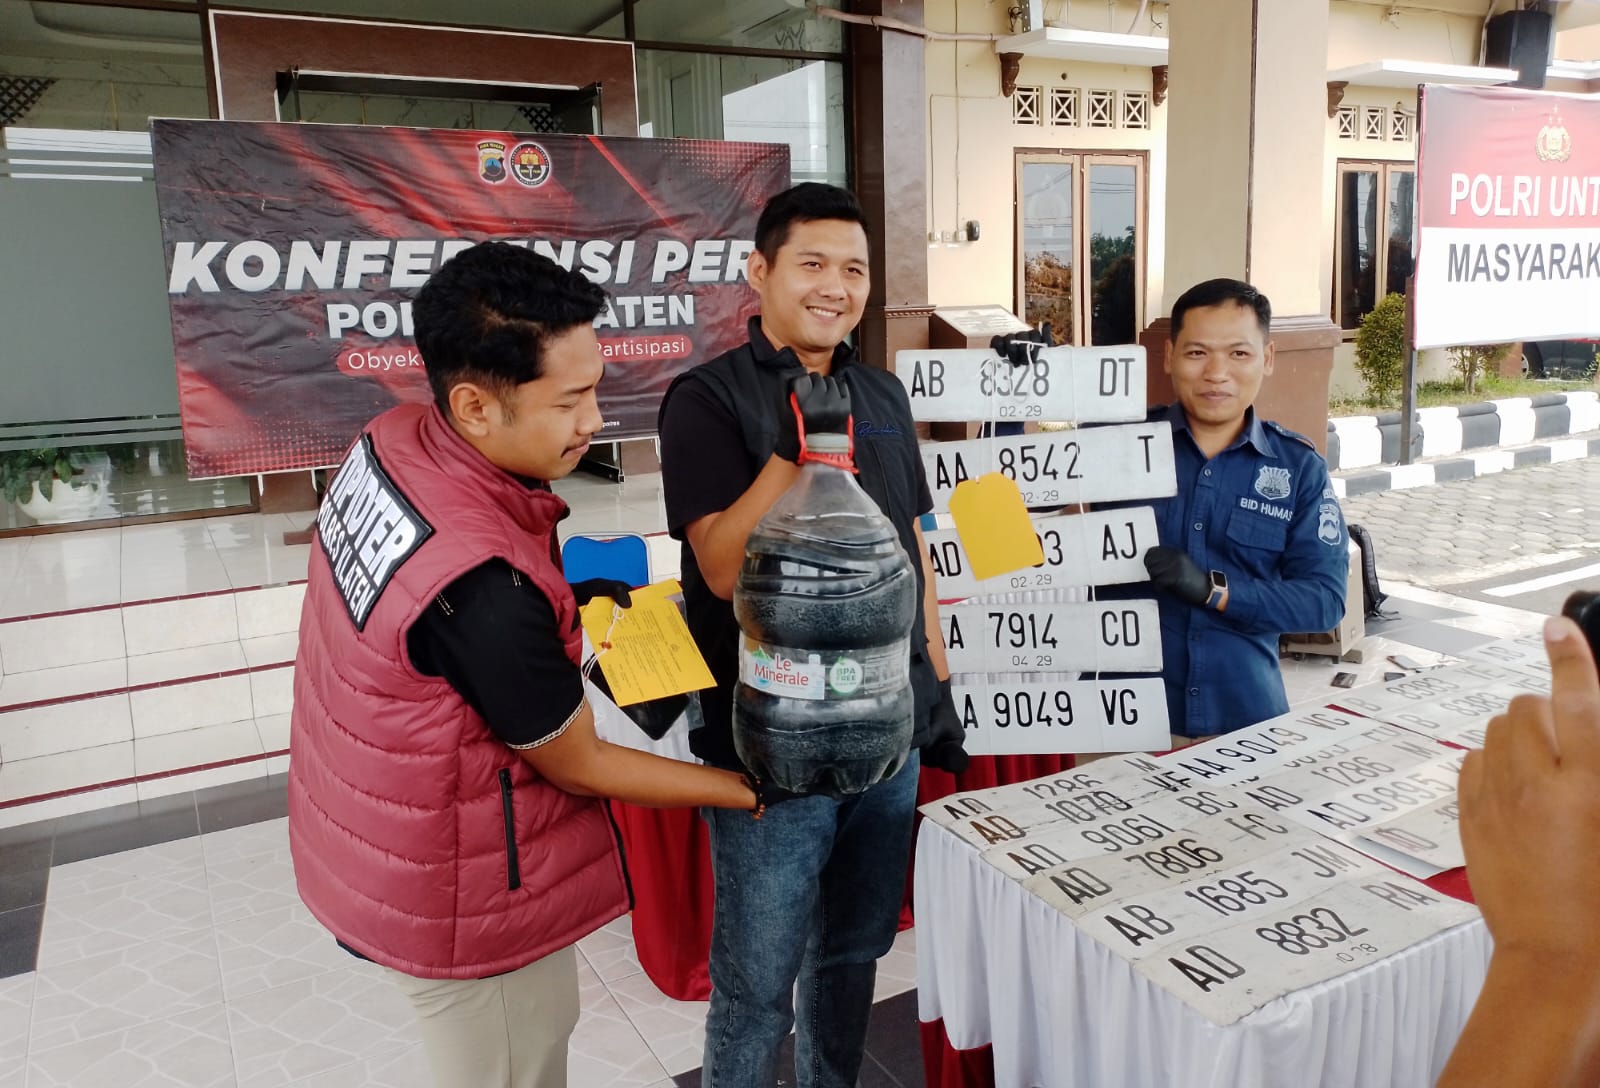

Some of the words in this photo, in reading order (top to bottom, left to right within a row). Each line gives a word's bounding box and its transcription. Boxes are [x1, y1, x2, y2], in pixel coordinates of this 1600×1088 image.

[1450, 172, 1541, 217] POLRI
[168, 239, 635, 294] KONFENSI
[348, 350, 425, 372] Obyek
[911, 359, 945, 398] AB
[1099, 357, 1136, 397] DT
[936, 452, 969, 490] AA
[1137, 435, 1155, 474] T
[1240, 497, 1259, 511] BID
[1260, 502, 1294, 522] HUMAS
[317, 492, 346, 562] POLRES
[334, 545, 376, 623] KLATEN
[1101, 521, 1138, 561] AJ
[988, 611, 1058, 650] 7914
[1101, 610, 1140, 647] CD
[754, 663, 810, 686] Minerale
[775, 653, 792, 672] Le
[993, 690, 1074, 729] 9049
[1100, 688, 1139, 726] VG
[1177, 757, 1235, 780] AA
[1215, 726, 1309, 764] 9049
[1245, 785, 1304, 812] AD
[1310, 756, 1395, 788] 1286
[1306, 801, 1371, 830] AD
[1351, 772, 1457, 813] 9895
[969, 815, 1027, 845] AD
[1081, 814, 1176, 852] 9061
[1176, 791, 1239, 817] BC
[1049, 866, 1113, 906] AD
[1122, 838, 1224, 879] 7806
[1104, 904, 1175, 947] AB
[1184, 870, 1289, 917] 1685
[1168, 944, 1246, 993] AD
[1255, 907, 1369, 956] 8832
[1360, 881, 1441, 911] RA
